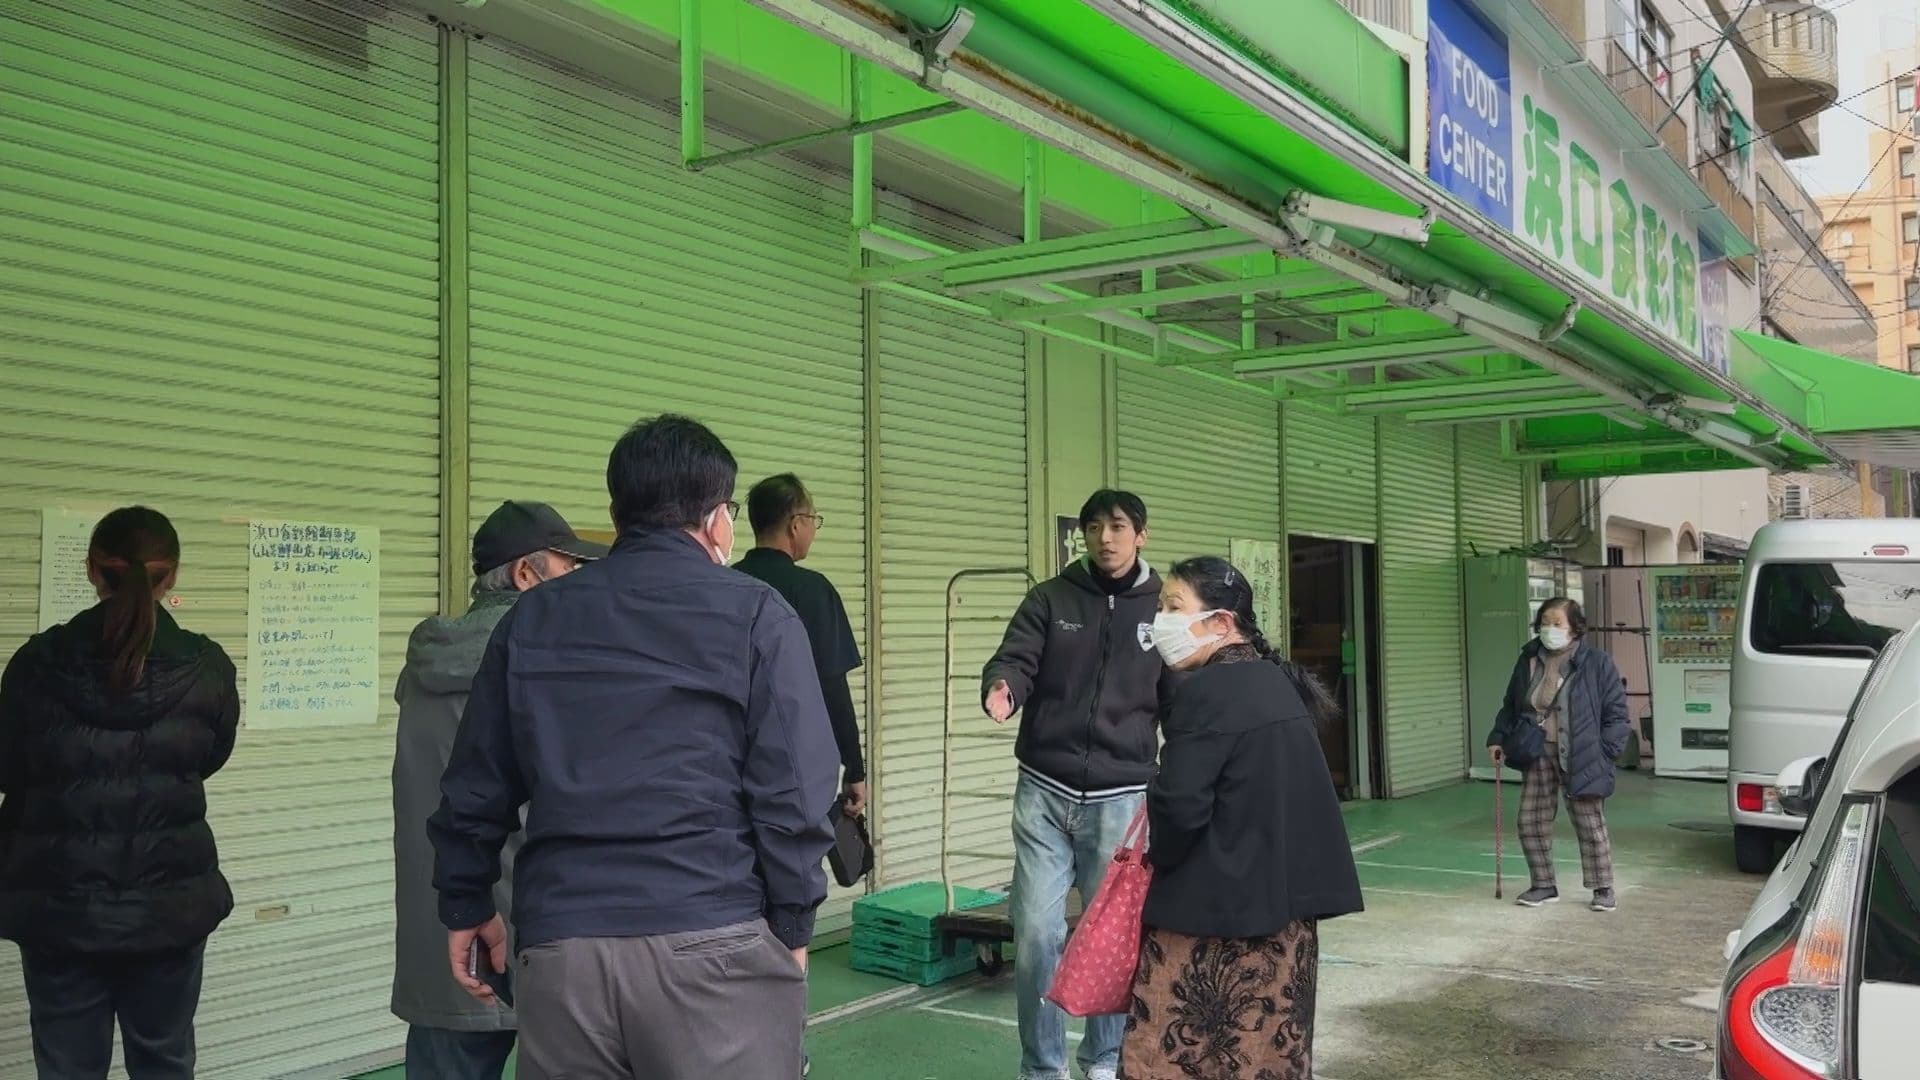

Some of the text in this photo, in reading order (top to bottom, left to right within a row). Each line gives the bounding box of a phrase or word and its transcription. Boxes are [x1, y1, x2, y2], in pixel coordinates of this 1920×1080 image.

[1451, 47, 1499, 128] FOOD
[1439, 112, 1508, 208] CENTER
[1523, 94, 1697, 347] 浜口食彩館
